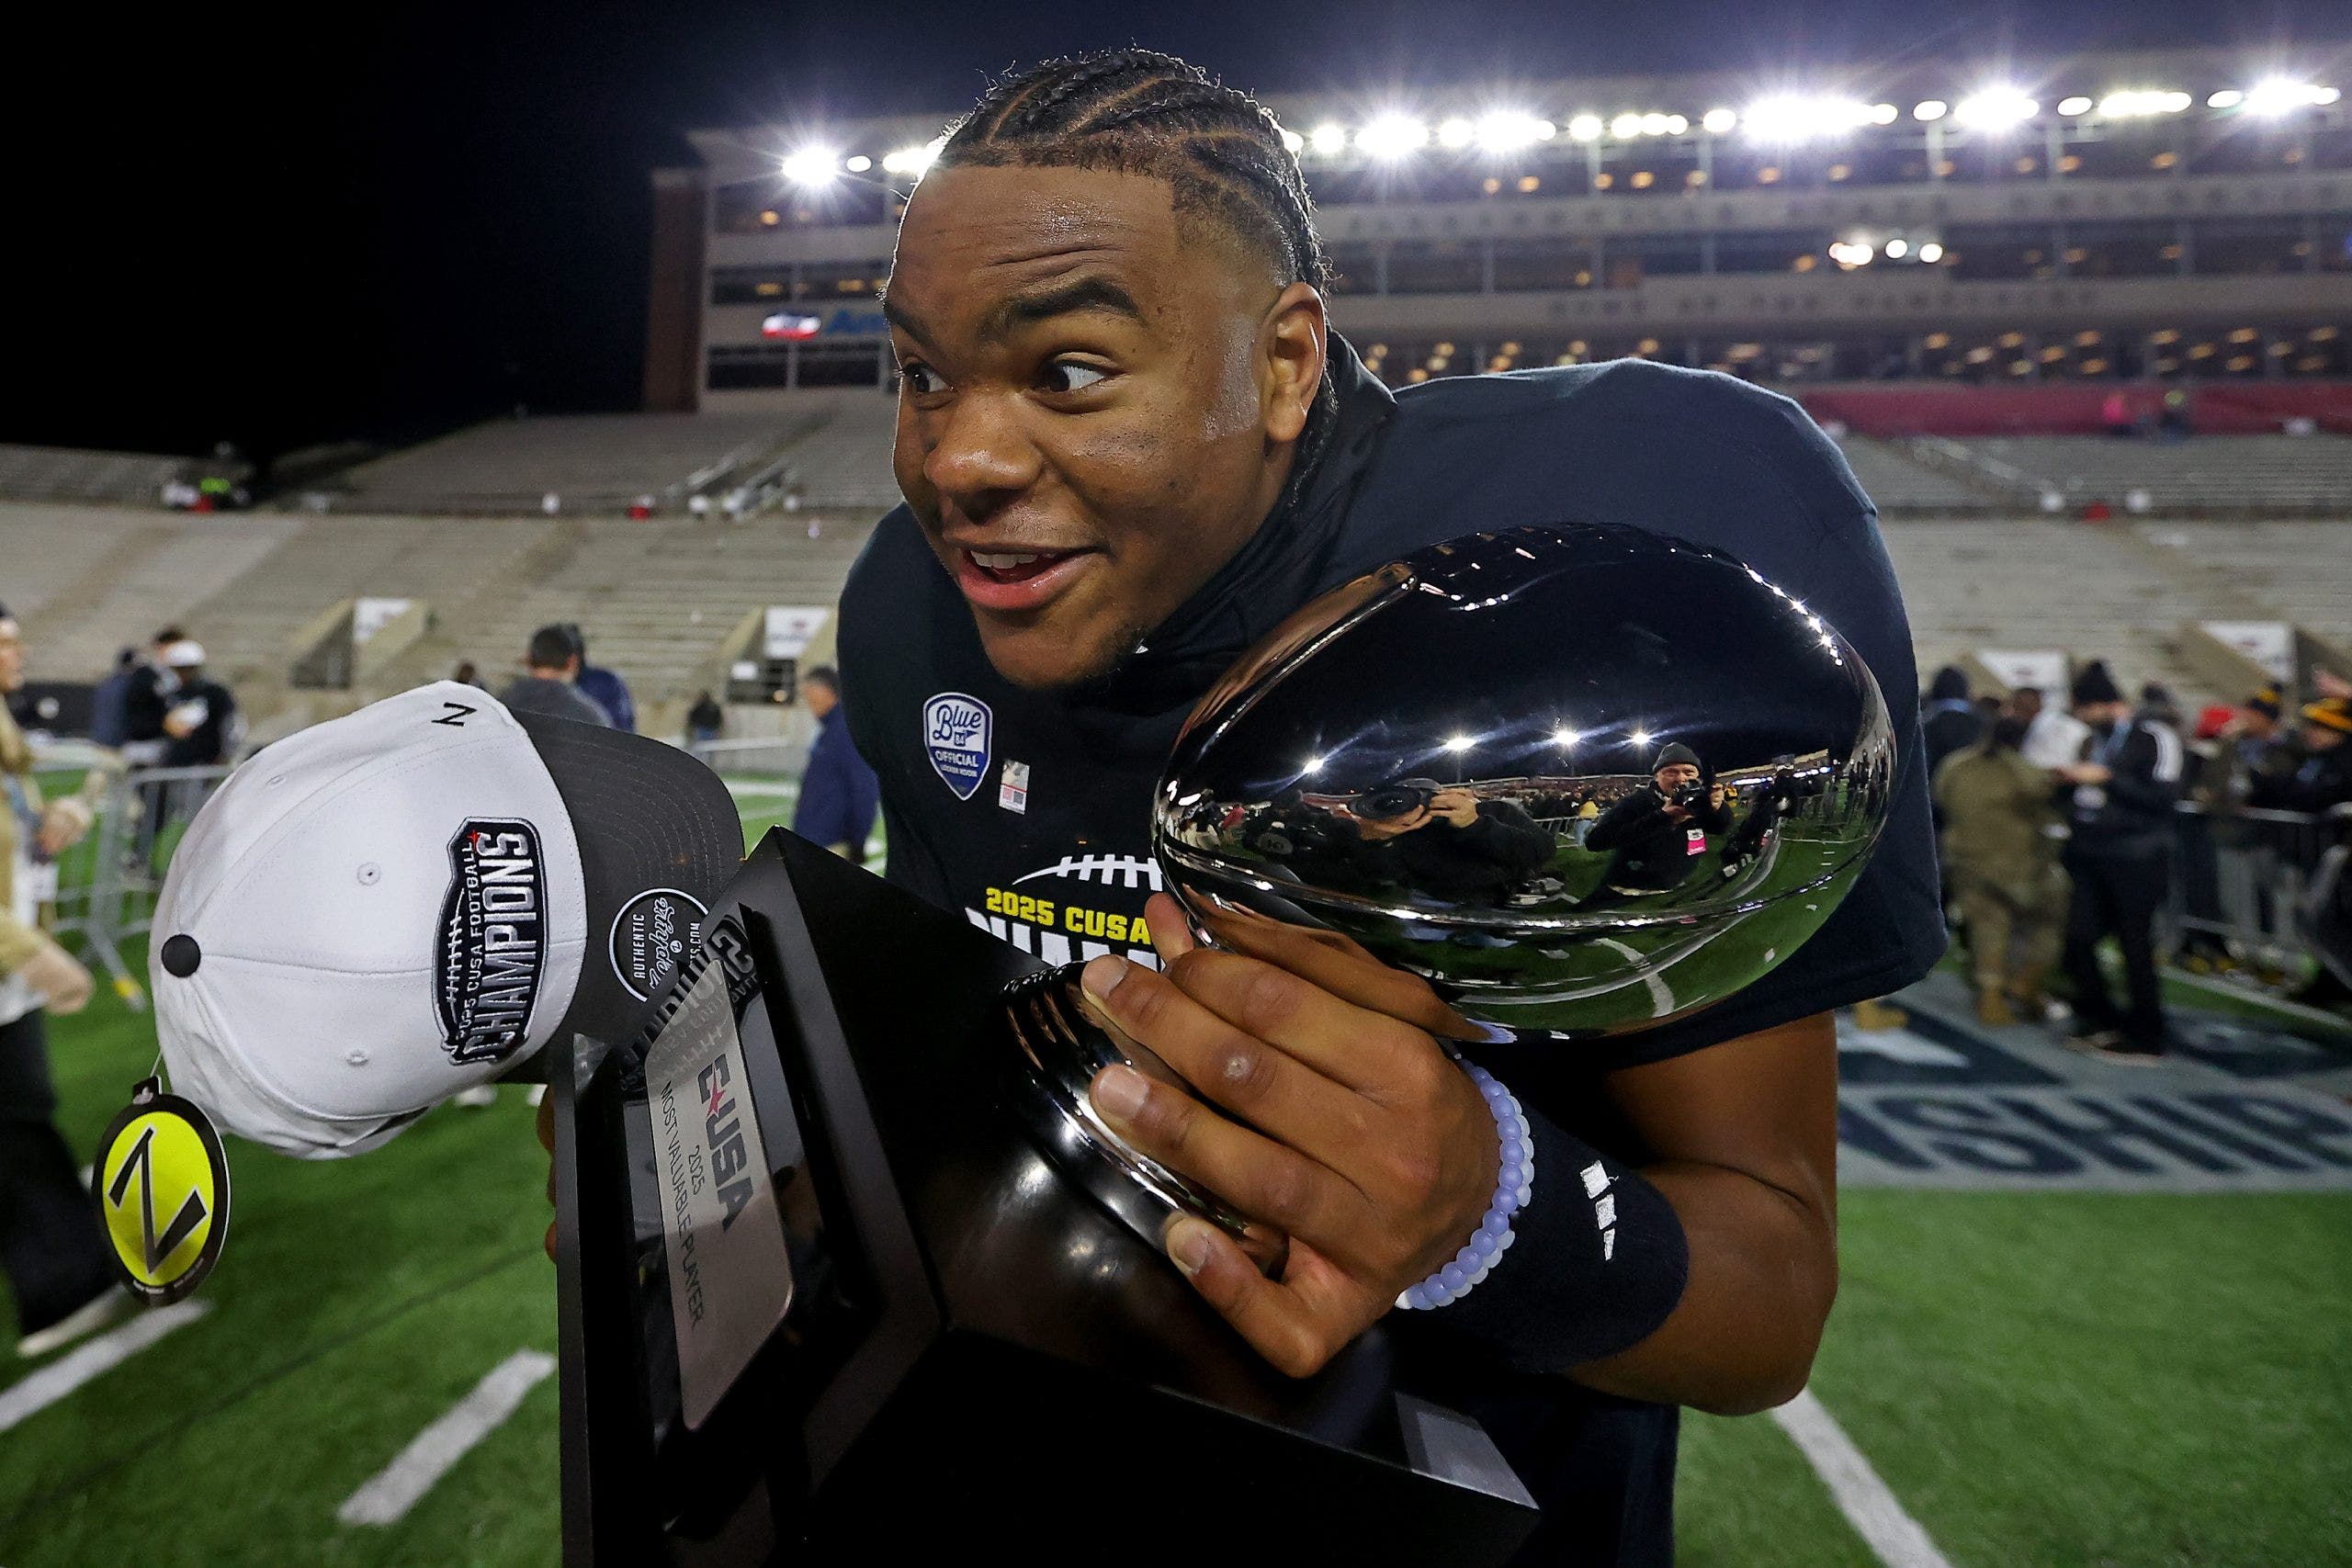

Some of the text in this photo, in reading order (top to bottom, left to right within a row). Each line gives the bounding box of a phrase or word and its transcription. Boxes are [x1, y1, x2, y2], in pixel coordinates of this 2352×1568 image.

[933, 704, 981, 741] Blue
[935, 750, 978, 768] OFFICIAL
[461, 842, 483, 939] FOOTBALL
[985, 886, 1055, 927] 2025
[1065, 906, 1152, 945] CUSA
[463, 831, 537, 1055] CHAMPIONS
[466, 944, 483, 992] CUSA
[632, 913, 646, 979] AUTHENTIC
[688, 1145, 705, 1196] 2025
[661, 1079, 704, 1331] MOST VALUABLE PLAYER
